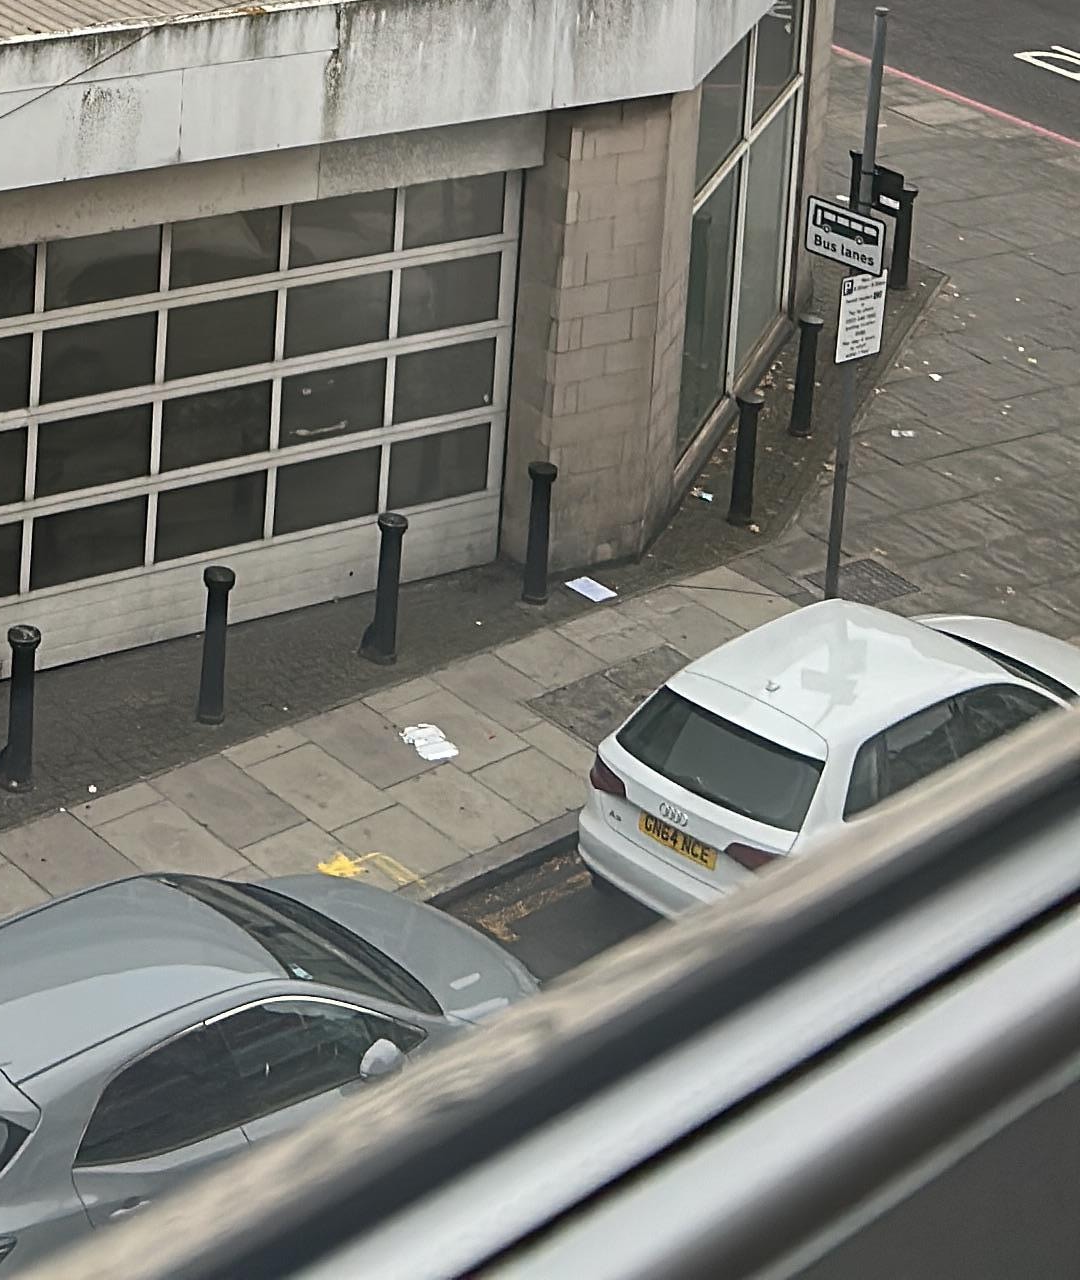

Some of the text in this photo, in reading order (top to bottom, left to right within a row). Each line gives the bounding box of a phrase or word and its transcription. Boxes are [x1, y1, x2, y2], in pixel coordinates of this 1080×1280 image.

[814, 234, 875, 266] Bus lanes
[644, 813, 709, 864] GN64 NCE
